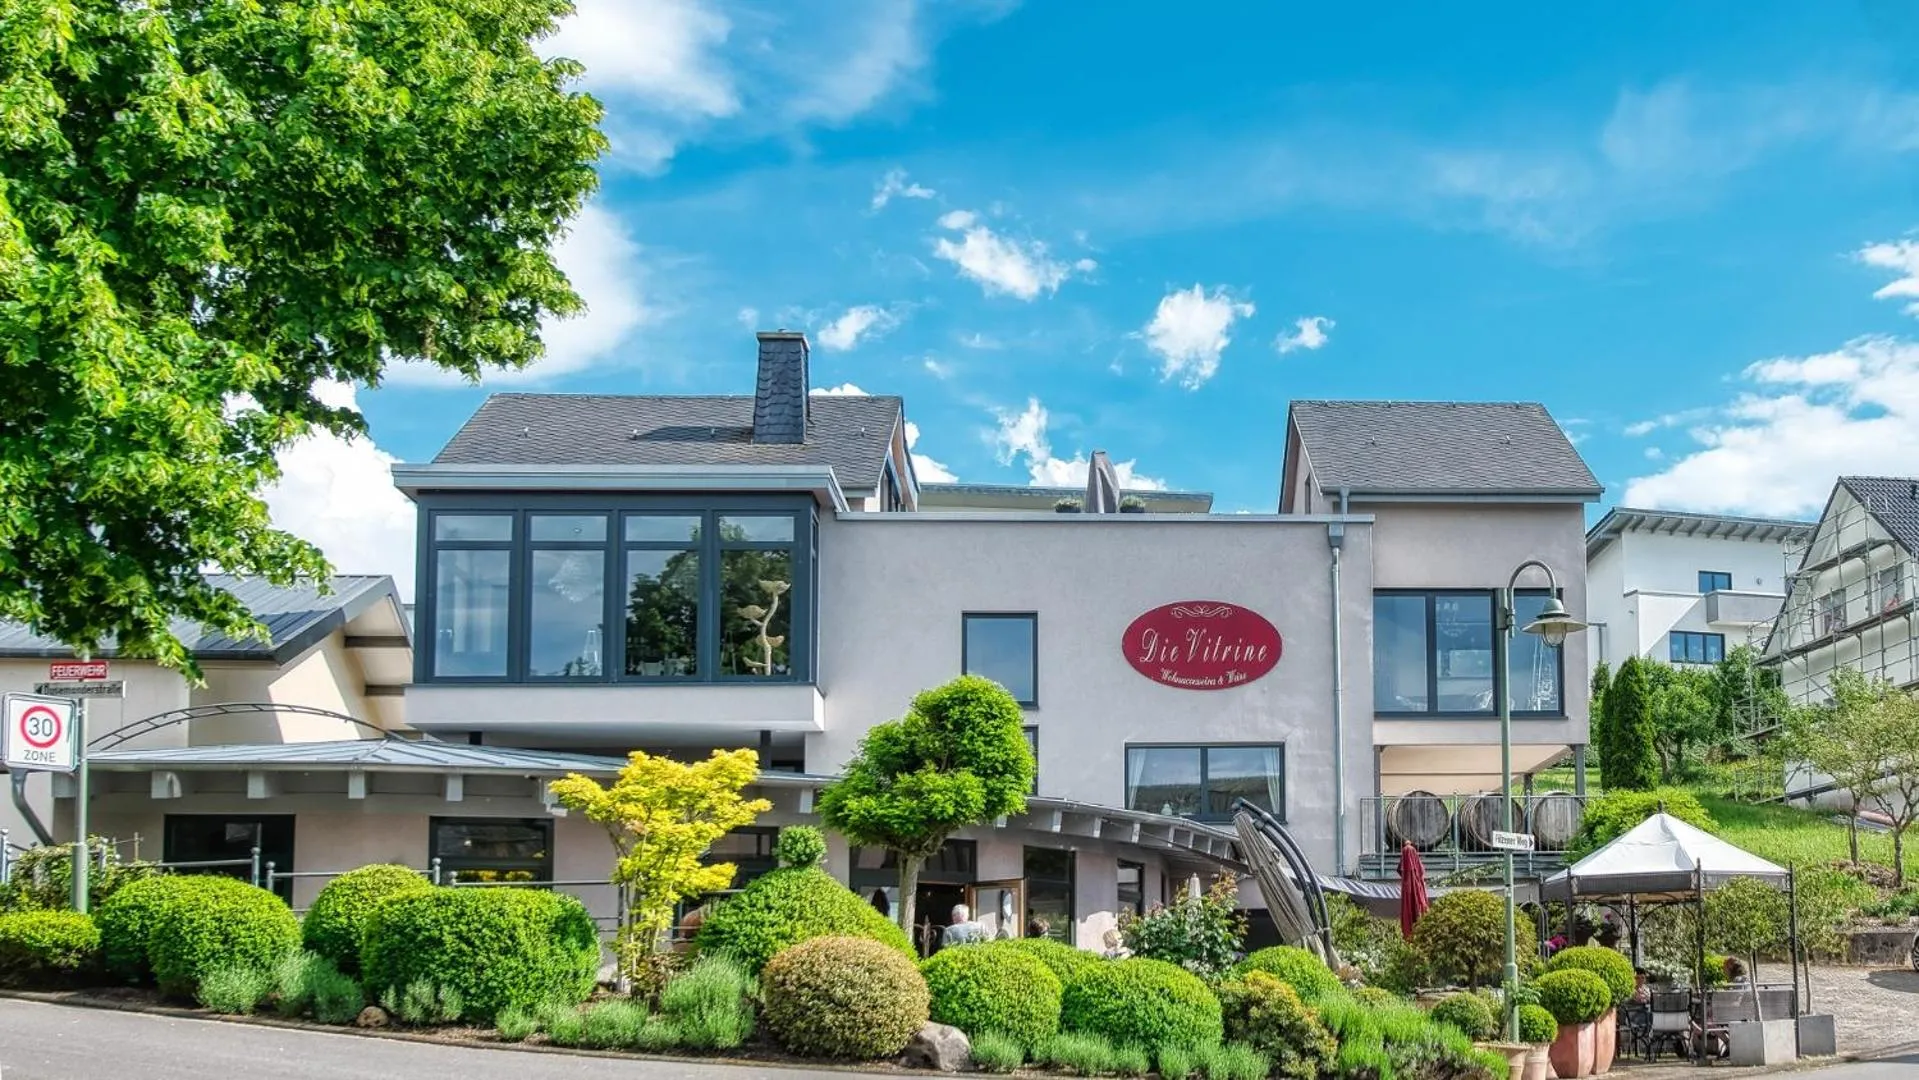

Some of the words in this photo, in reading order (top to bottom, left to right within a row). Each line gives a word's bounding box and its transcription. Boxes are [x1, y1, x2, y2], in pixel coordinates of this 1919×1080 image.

[1139, 627, 1179, 663] Die
[1185, 627, 1268, 663] Vitrine
[51, 664, 106, 677] FEUERWEHR
[28, 716, 54, 737] 30
[23, 749, 56, 763] ZONE
